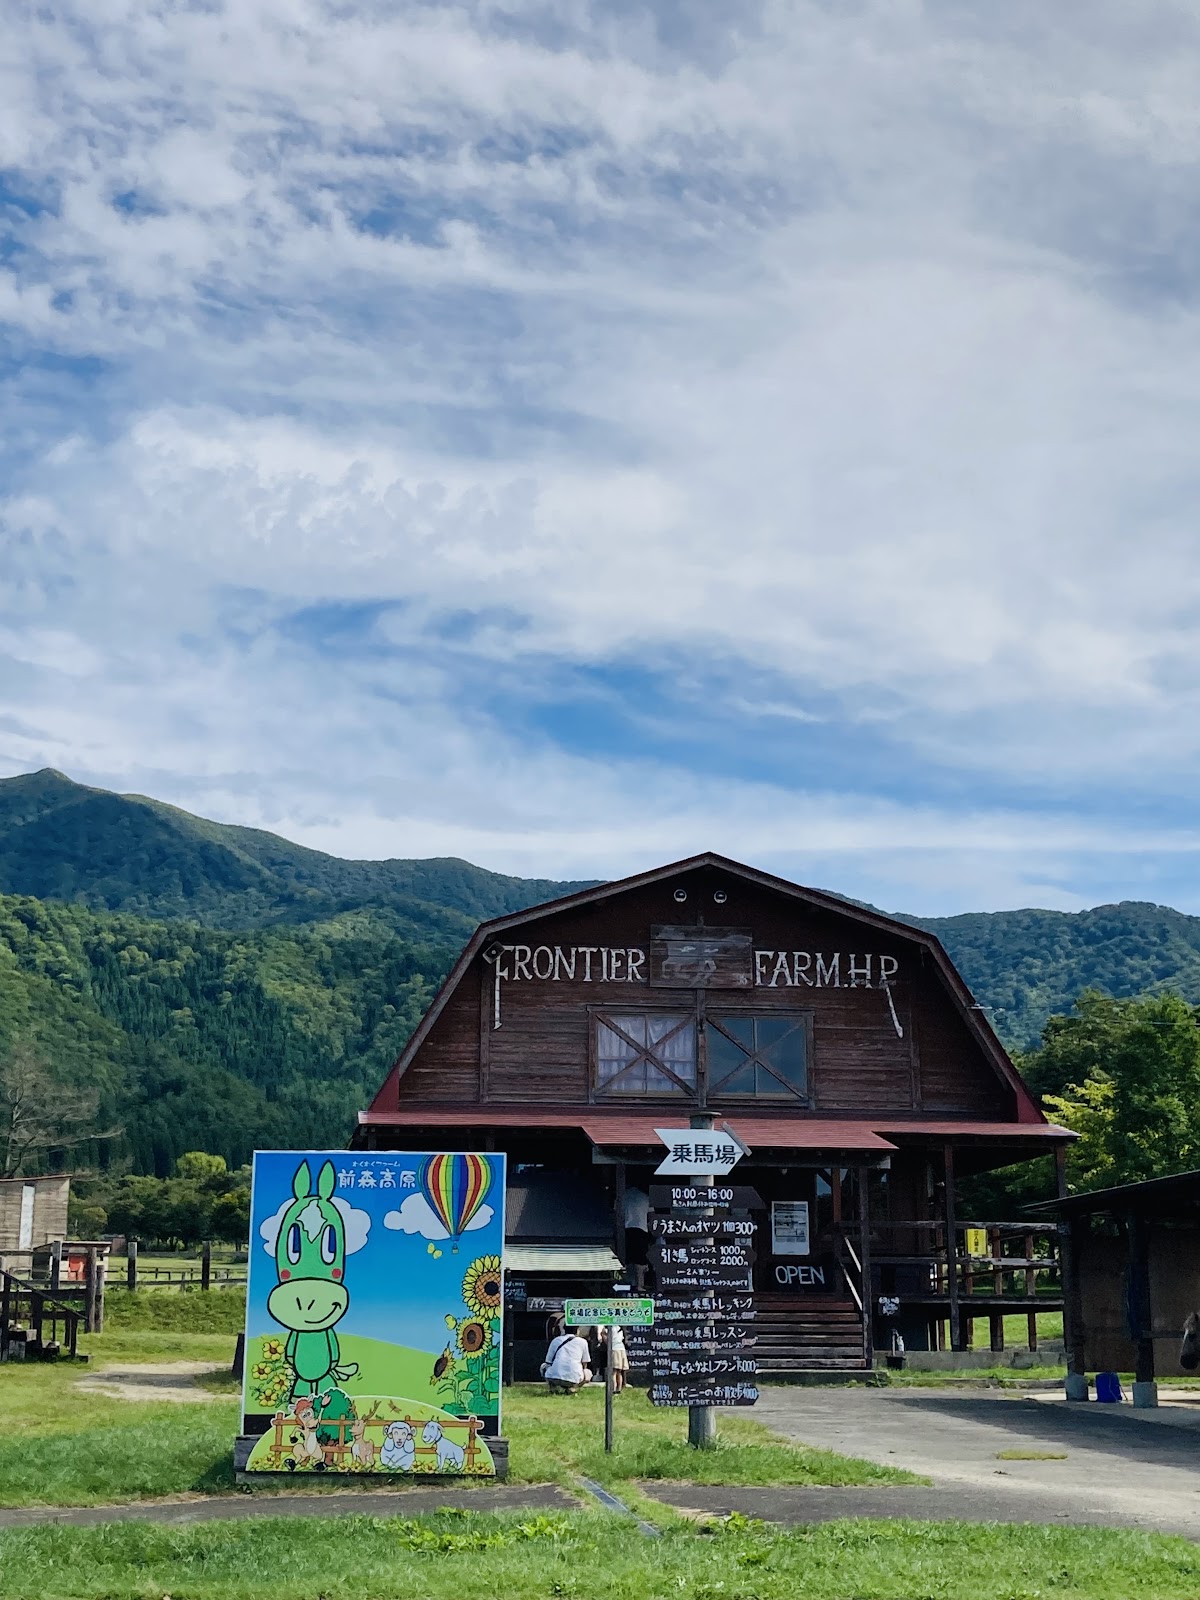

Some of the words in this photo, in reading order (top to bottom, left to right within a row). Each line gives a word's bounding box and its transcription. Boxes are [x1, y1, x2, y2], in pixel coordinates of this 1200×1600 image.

[672, 1144, 736, 1164] 乗馬場
[337, 1168, 416, 1188] 前森高原
[660, 1220, 720, 1234] うまさんのオヤツ
[661, 1248, 688, 1264] 引き馬
[775, 1265, 825, 1284] OPEN
[692, 1298, 753, 1310] 乗馬トレッキング
[694, 1327, 746, 1339] 乗馬レッスン
